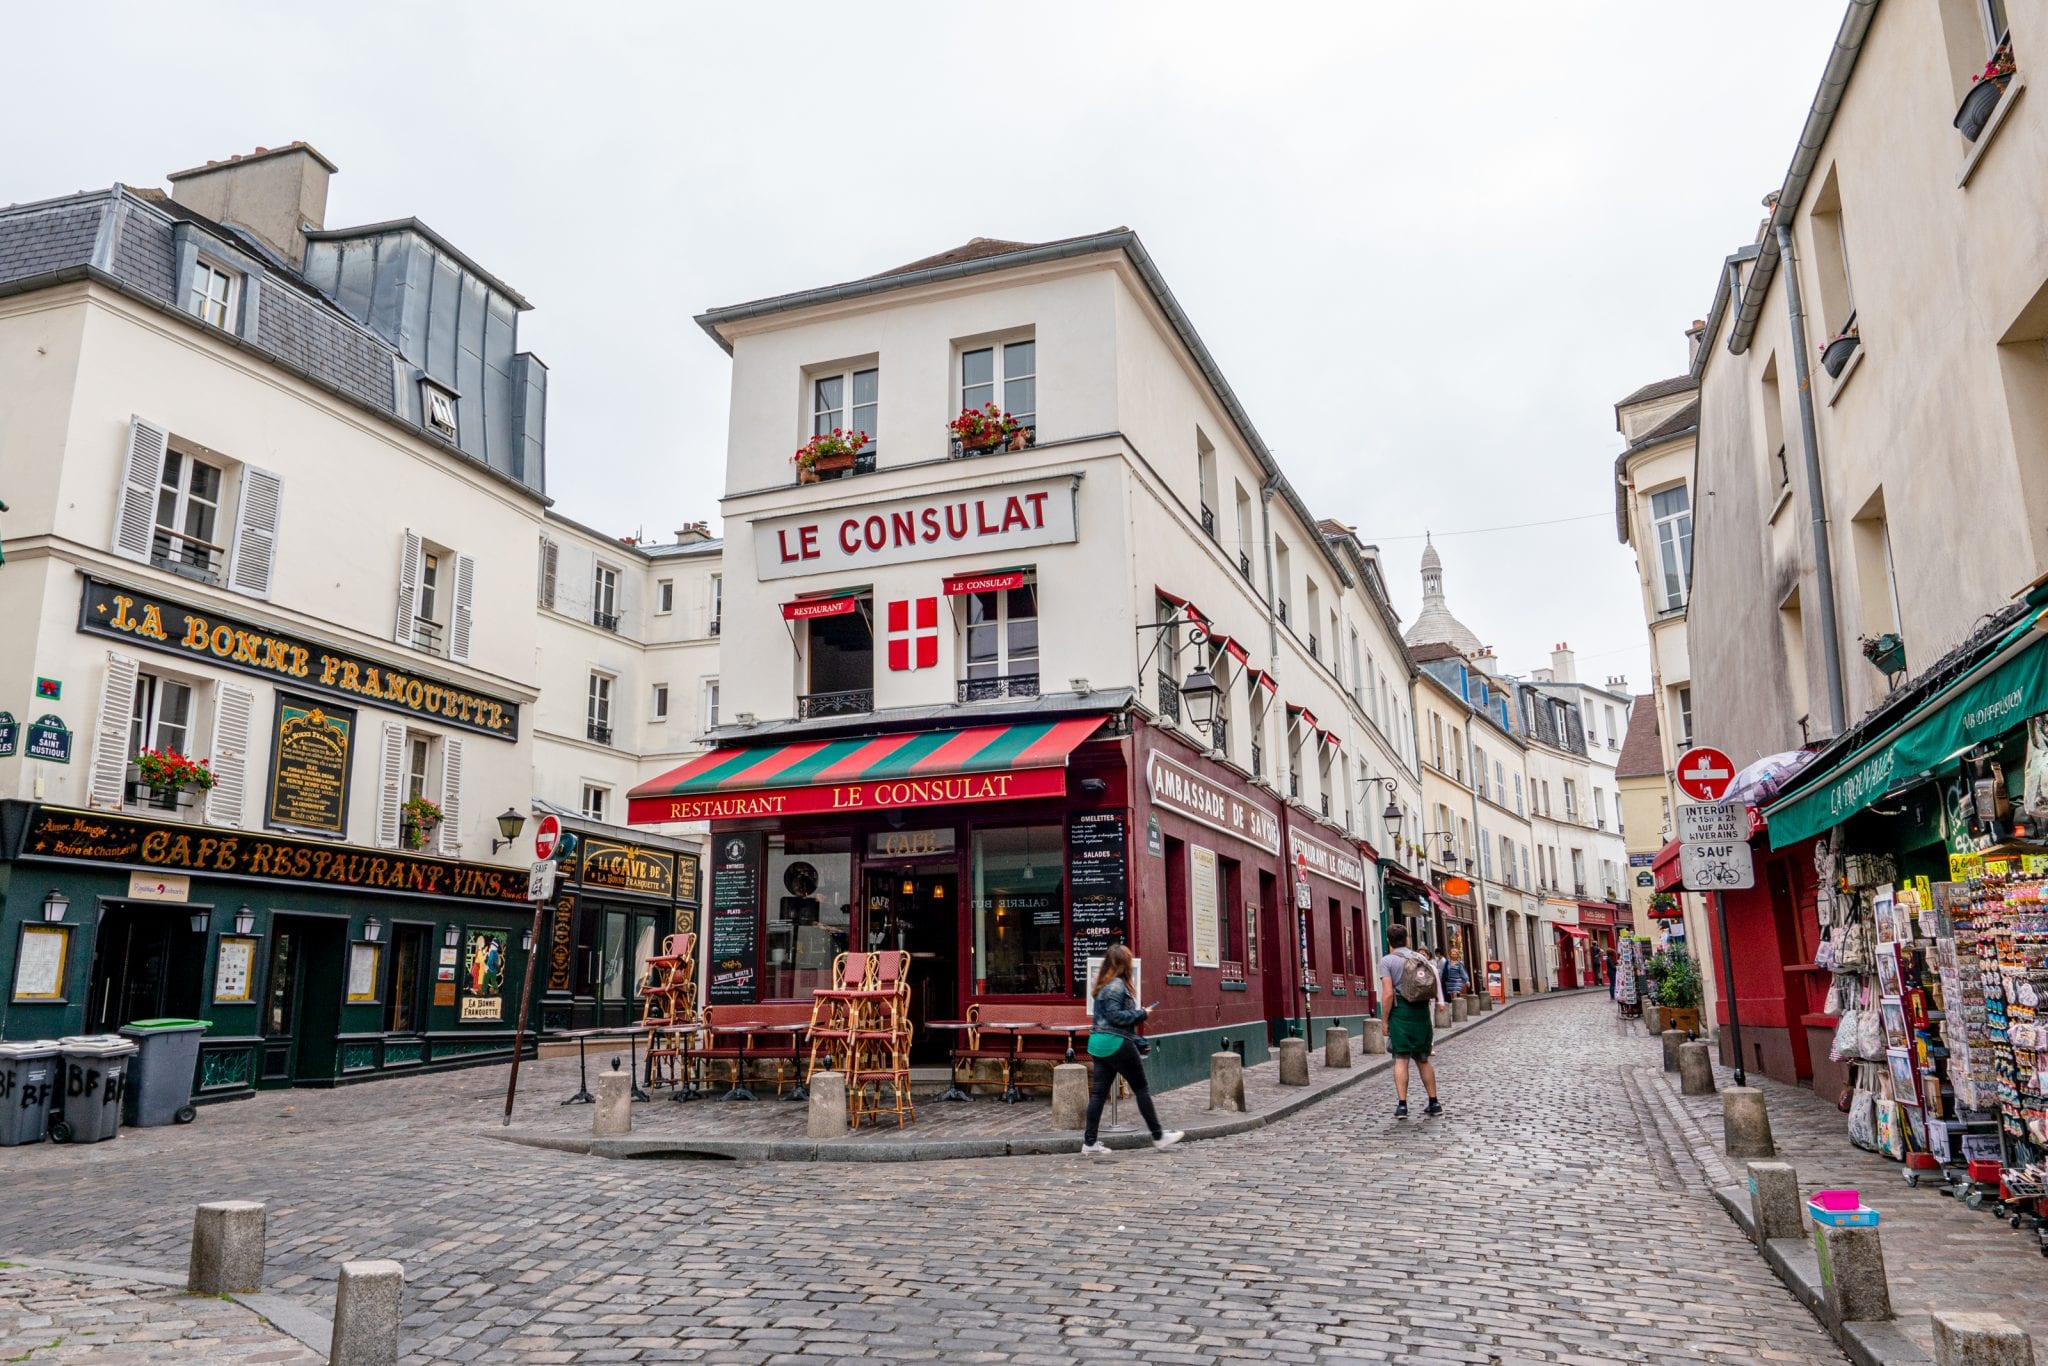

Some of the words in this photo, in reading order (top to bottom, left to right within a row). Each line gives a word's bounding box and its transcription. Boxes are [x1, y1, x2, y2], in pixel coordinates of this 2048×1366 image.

[778, 525, 821, 563] LE
[839, 491, 1048, 555] CONSULAT
[953, 582, 964, 591] LE
[967, 577, 1014, 590] CONSULAT
[794, 601, 844, 616] RESTAURANT
[111, 594, 168, 641] LA
[181, 614, 310, 678] BONNE
[320, 654, 504, 730] FRANQUETTE
[1976, 686, 2023, 724] DIFFUSION
[0, 728, 9, 737] UE
[43, 731, 58, 741] RUE
[39, 738, 60, 749] SAINT
[31, 745, 65, 758] RUSTIQUE
[671, 795, 786, 819] RESTAURANT
[833, 787, 863, 808] LE
[874, 774, 1013, 806] CONSULAT
[1155, 766, 1225, 821] AMBASSADE
[1233, 803, 1244, 829] DE
[1250, 812, 1277, 845] SAVOIE
[1686, 804, 1735, 816] INTERDIT
[1081, 814, 1115, 822] OMELETTES
[1697, 824, 1713, 832] AUF
[1718, 823, 1735, 831] AUX
[1696, 845, 1733, 858] SAUF
[142, 830, 239, 870] CAFÉ
[249, 843, 444, 892] RESTAURANT
[452, 867, 503, 898] VINS
[599, 856, 609, 871] LA
[610, 856, 647, 879] CAVE
[650, 865, 661, 879] DE
[1329, 854, 1337, 873] LE
[625, 876, 660, 890] FRANQUETTE
[468, 999, 476, 1008] LA
[478, 999, 496, 1008] BONNE
[464, 1008, 499, 1017] FRANQUETTE
